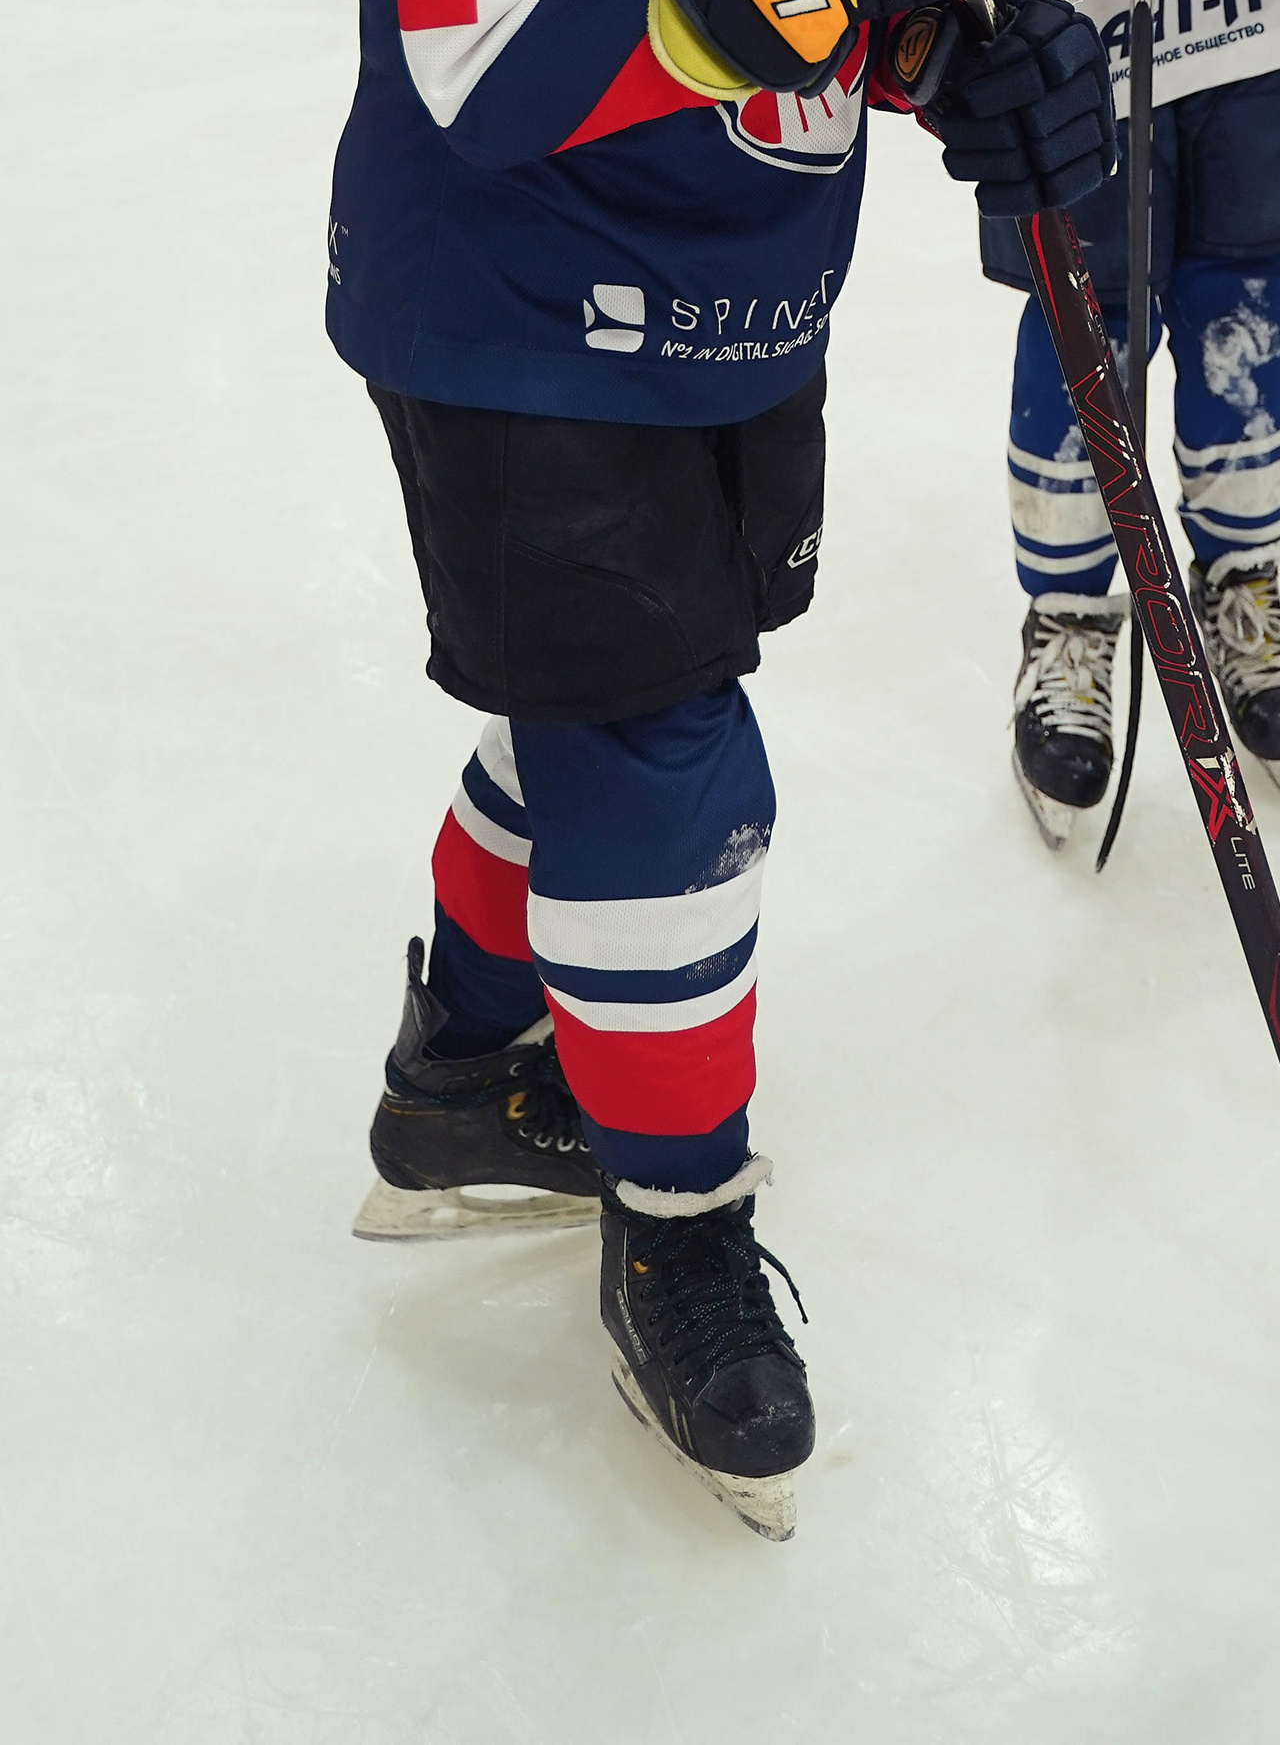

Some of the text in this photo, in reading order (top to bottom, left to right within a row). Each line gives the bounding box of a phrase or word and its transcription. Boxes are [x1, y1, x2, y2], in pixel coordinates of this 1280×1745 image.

[1184, 22, 1265, 56] ОБЩЕСТВО
[671, 269, 835, 335] SPINET
[693, 348, 717, 361] IN
[715, 341, 769, 362] DIGITAL
[1230, 834, 1256, 891] LITE
